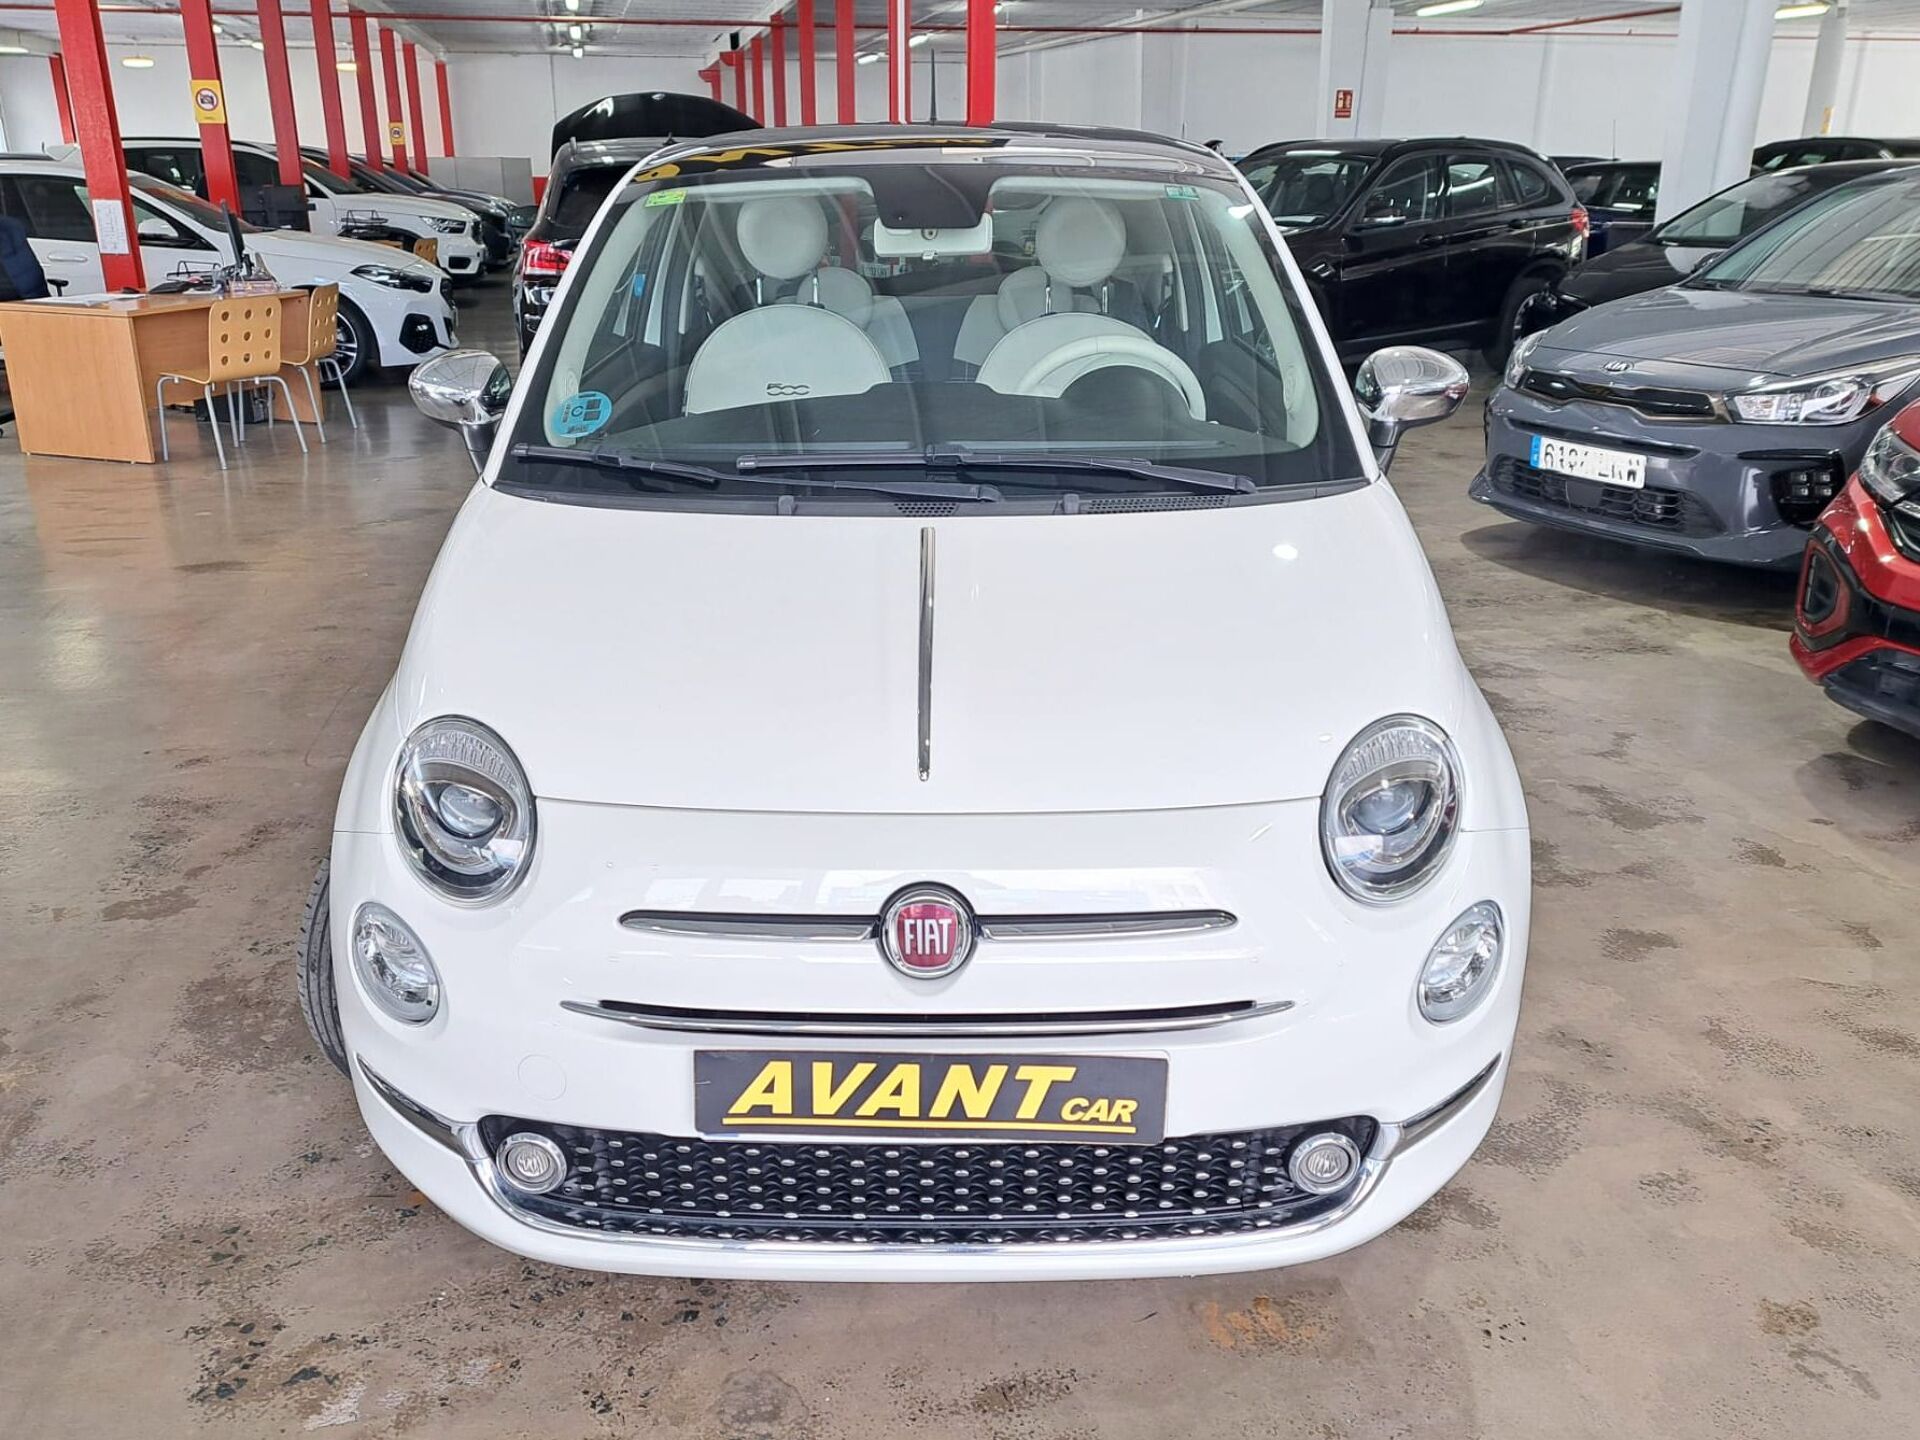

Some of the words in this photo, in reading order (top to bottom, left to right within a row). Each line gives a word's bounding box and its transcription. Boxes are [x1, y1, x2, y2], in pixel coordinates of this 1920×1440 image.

[766, 383, 810, 396] 500
[904, 918, 952, 955] FIAT
[727, 1060, 1076, 1120] AVANT
[1061, 1097, 1138, 1123] CAR
